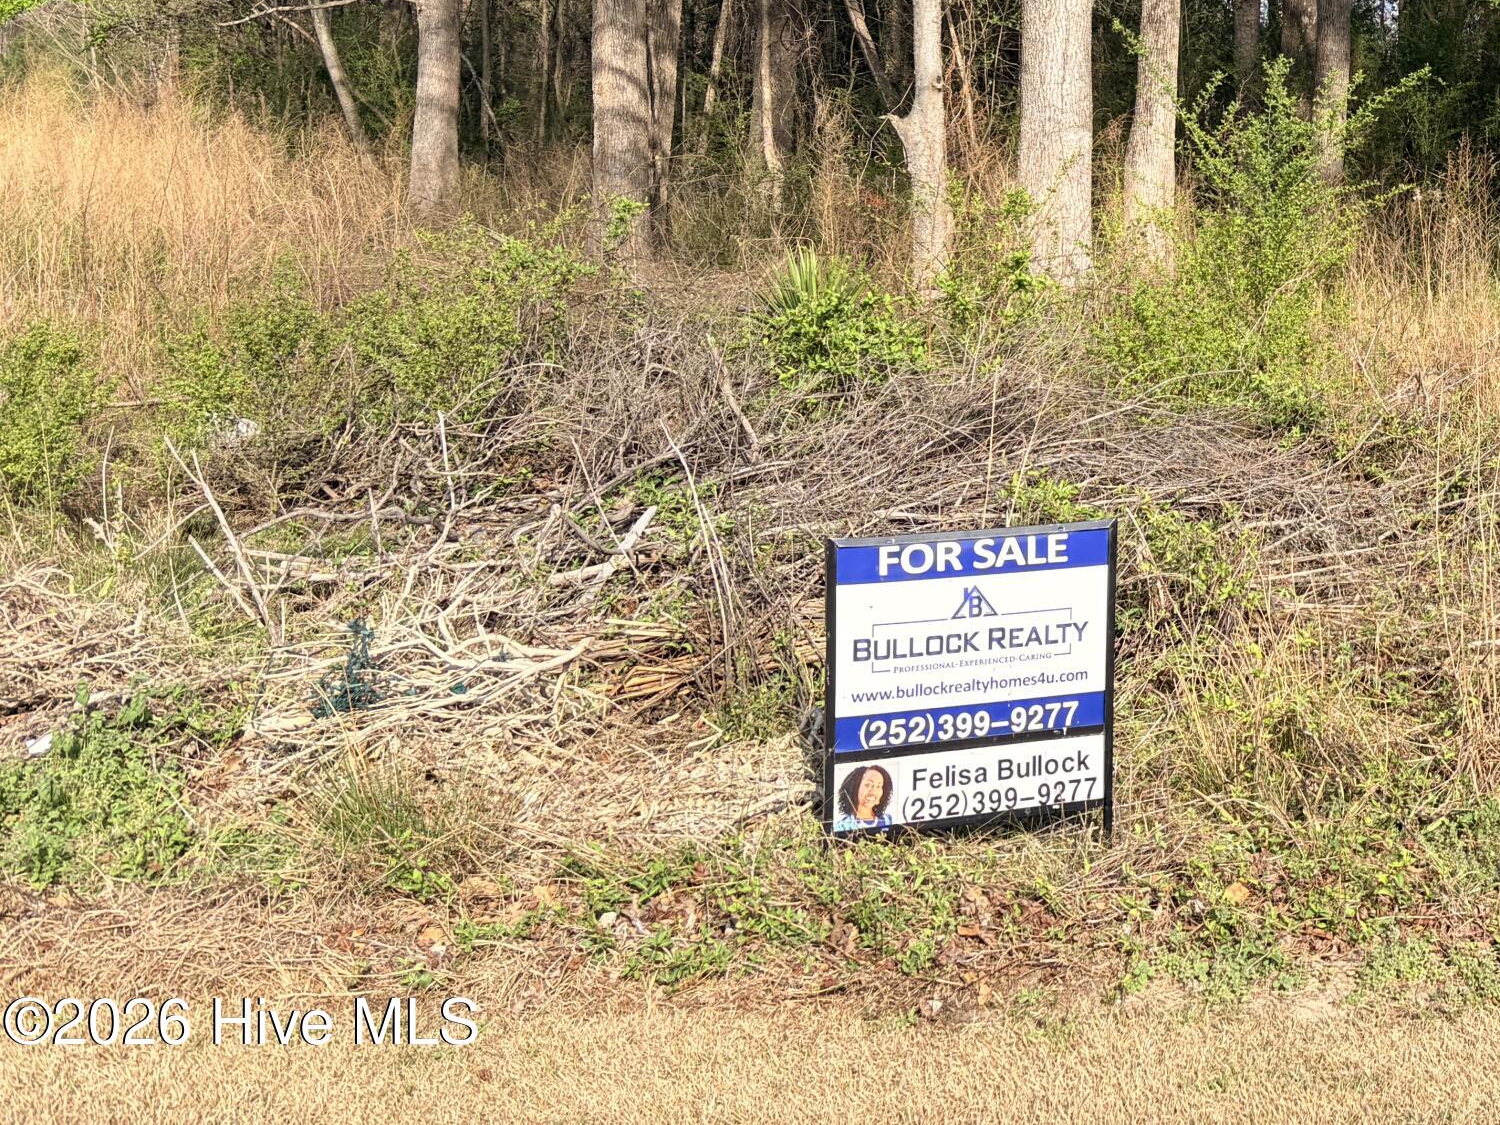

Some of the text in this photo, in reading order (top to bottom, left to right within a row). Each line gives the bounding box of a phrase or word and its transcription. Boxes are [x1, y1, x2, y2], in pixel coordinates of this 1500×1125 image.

[878, 533, 1069, 576] FOR SALE
[853, 621, 1089, 662] BULLOCK REALTY
[851, 670, 1089, 703] www.bullockrealtyhomes4u.com
[859, 701, 1079, 750] (252)399-9277
[912, 750, 1090, 791] Felisa Bullock
[902, 777, 1098, 821] (252)399-9277
